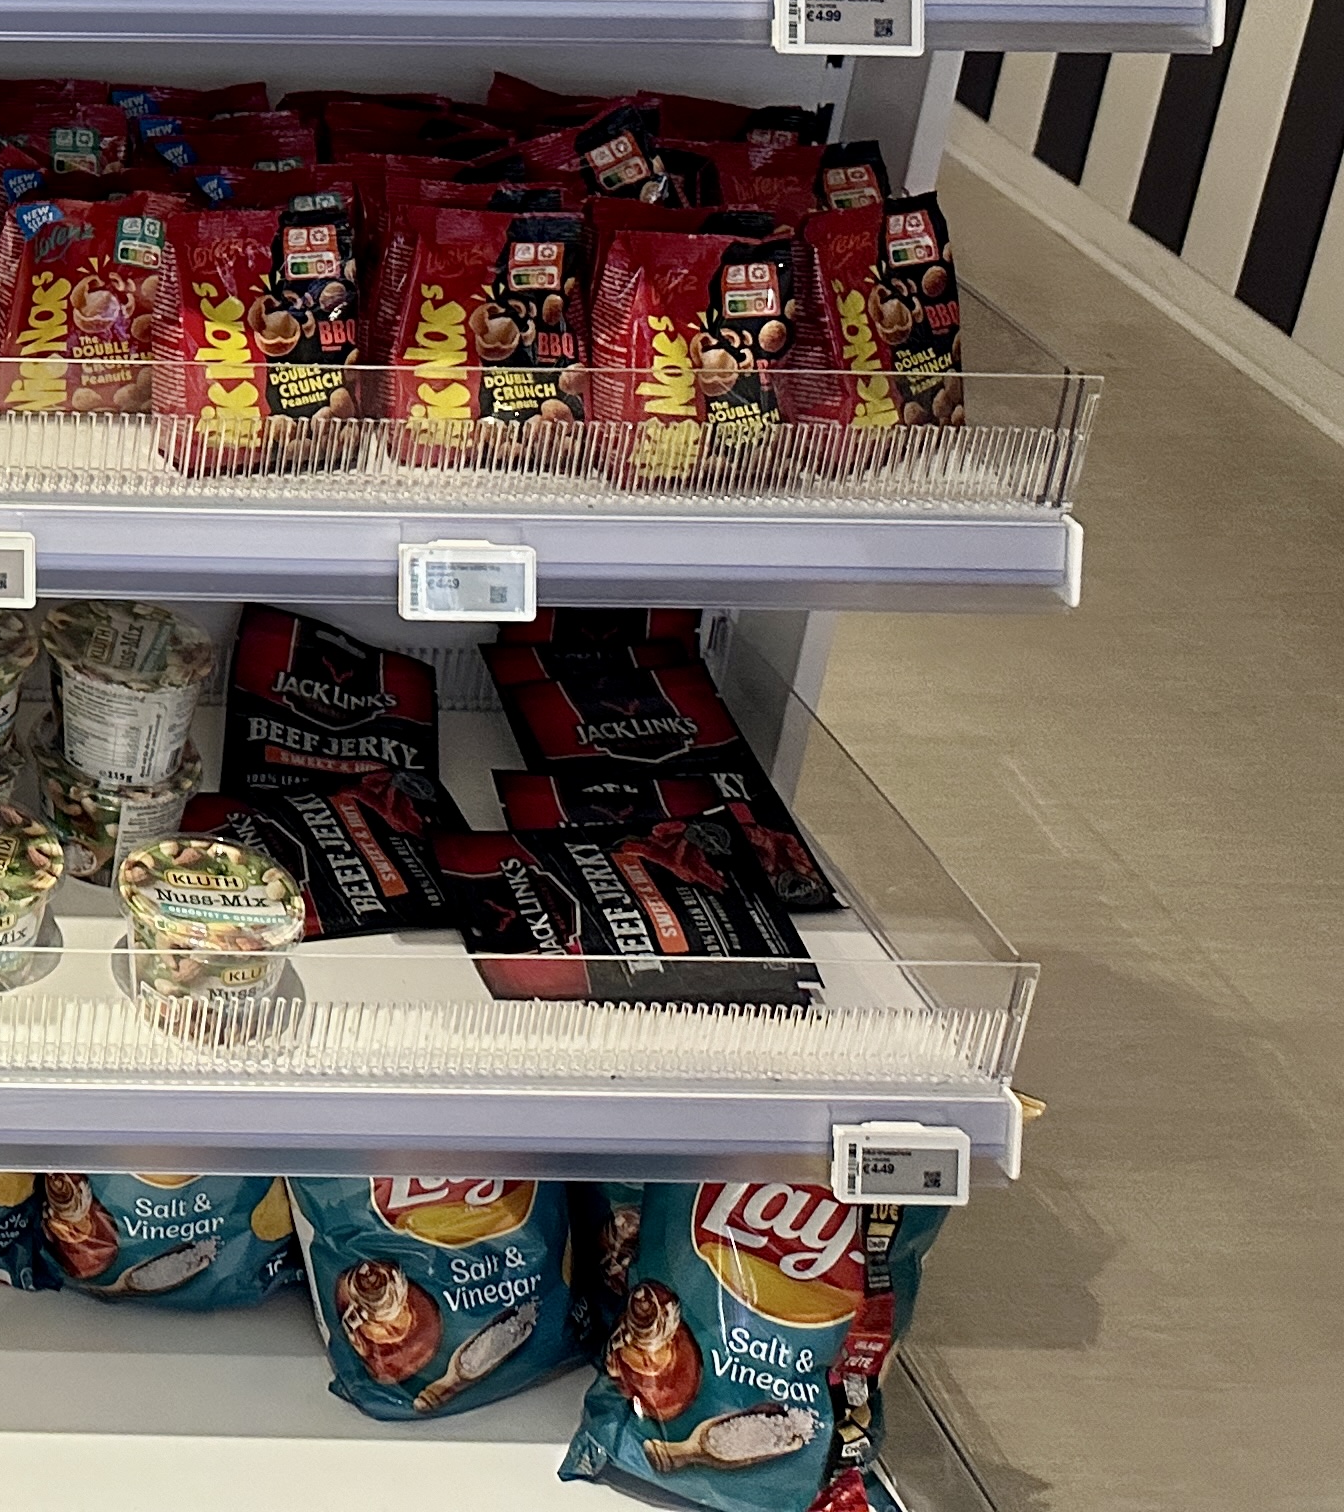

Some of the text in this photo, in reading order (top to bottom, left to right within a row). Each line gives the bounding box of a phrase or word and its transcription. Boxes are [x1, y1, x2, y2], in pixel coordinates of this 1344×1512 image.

[22, 209, 49, 222] NEW
[320, 319, 355, 346] BBQ
[538, 332, 573, 359] BBQ
[72, 342, 130, 359] DOUBLE
[279, 372, 343, 398] CRUNCH
[483, 373, 534, 389] DOUBLE
[493, 383, 557, 402] CRUNCH
[280, 391, 327, 410] Peanuts
[247, 717, 425, 769] BEEF JERKY
[171, 874, 240, 887] KLUTH
[328, 851, 387, 915] BEEF
[156, 888, 269, 908] Nuss-Mix
[135, 1193, 212, 1218] Salt &
[123, 1214, 224, 1241] Vinegar
[450, 1246, 526, 1284] Salt &
[443, 1272, 541, 1312] Vinegar
[729, 1327, 814, 1372] Salt &
[711, 1348, 820, 1405] Vinegar
